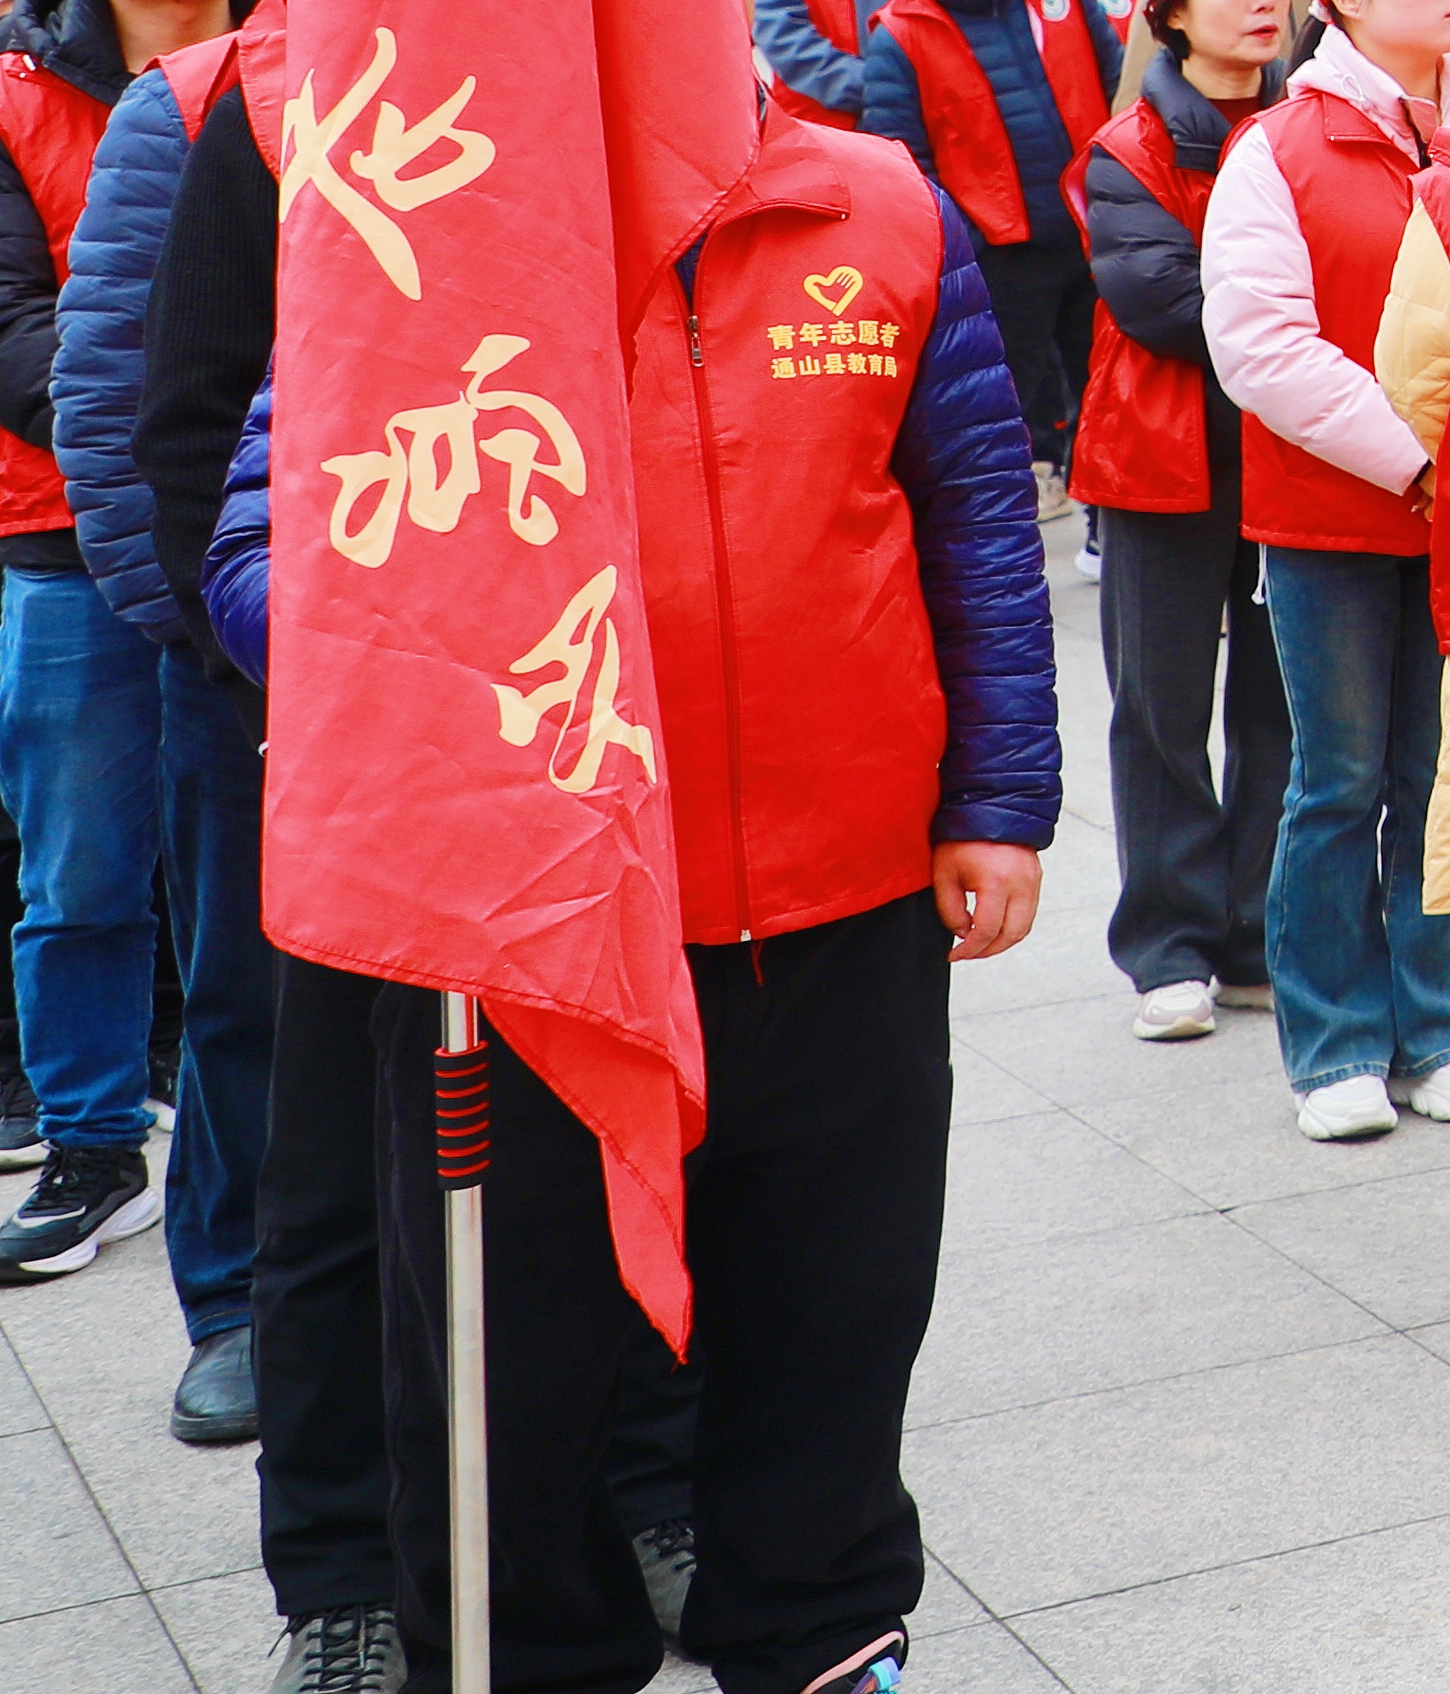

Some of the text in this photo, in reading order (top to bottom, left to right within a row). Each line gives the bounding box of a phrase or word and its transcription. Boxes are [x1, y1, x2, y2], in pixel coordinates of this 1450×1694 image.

[767, 320, 901, 351] 青年志愿者
[770, 352, 899, 381] 通山县教育局
